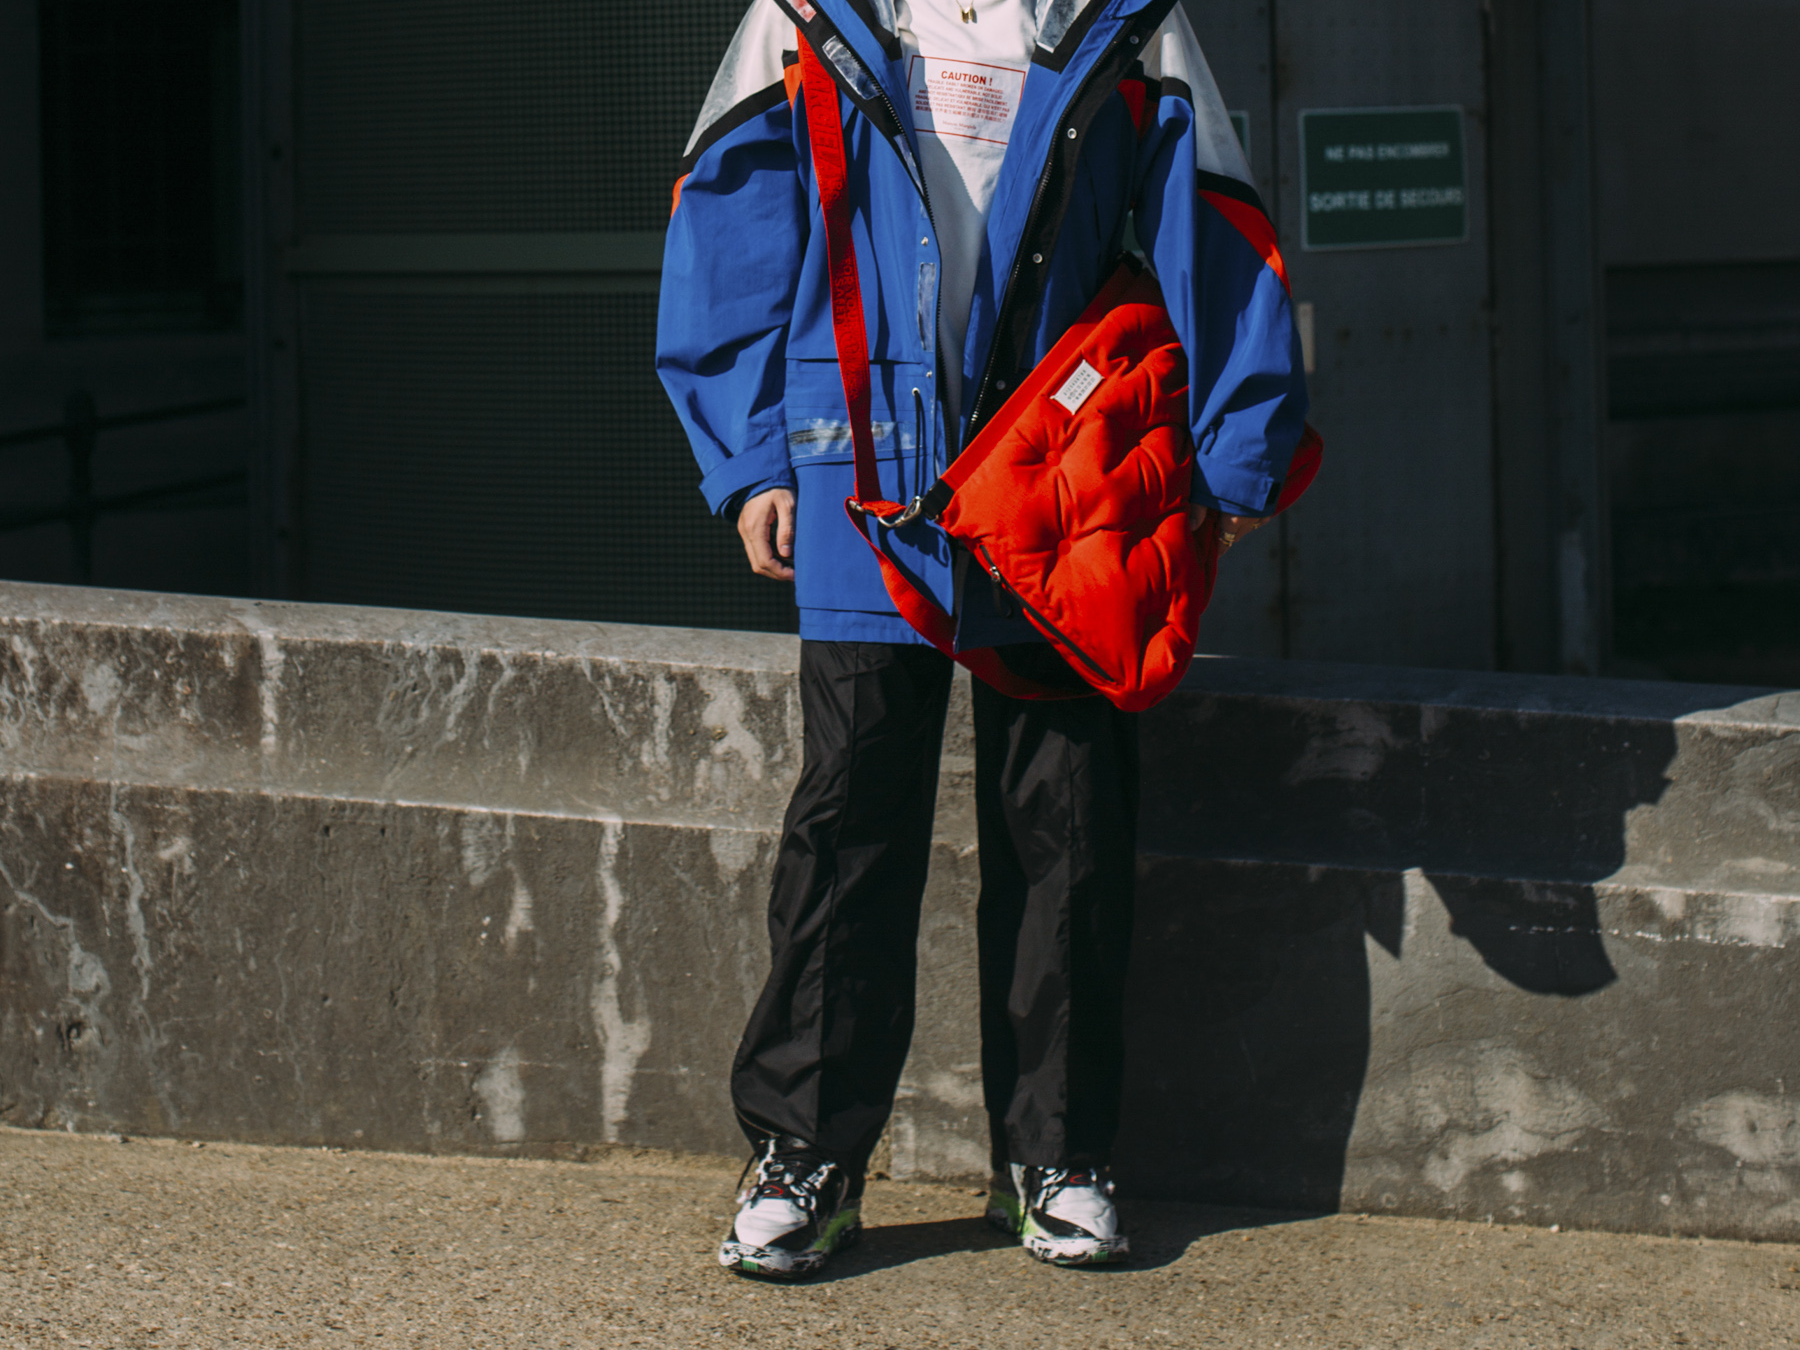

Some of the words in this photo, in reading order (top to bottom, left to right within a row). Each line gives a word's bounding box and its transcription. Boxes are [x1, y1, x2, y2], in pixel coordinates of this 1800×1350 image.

[941, 71, 987, 85] CAUTION
[1325, 146, 1344, 161] NE
[1348, 144, 1373, 160] PAS
[1310, 191, 1370, 211] SORTIE
[1374, 189, 1395, 209] DE
[1400, 187, 1463, 208] SECOURS
